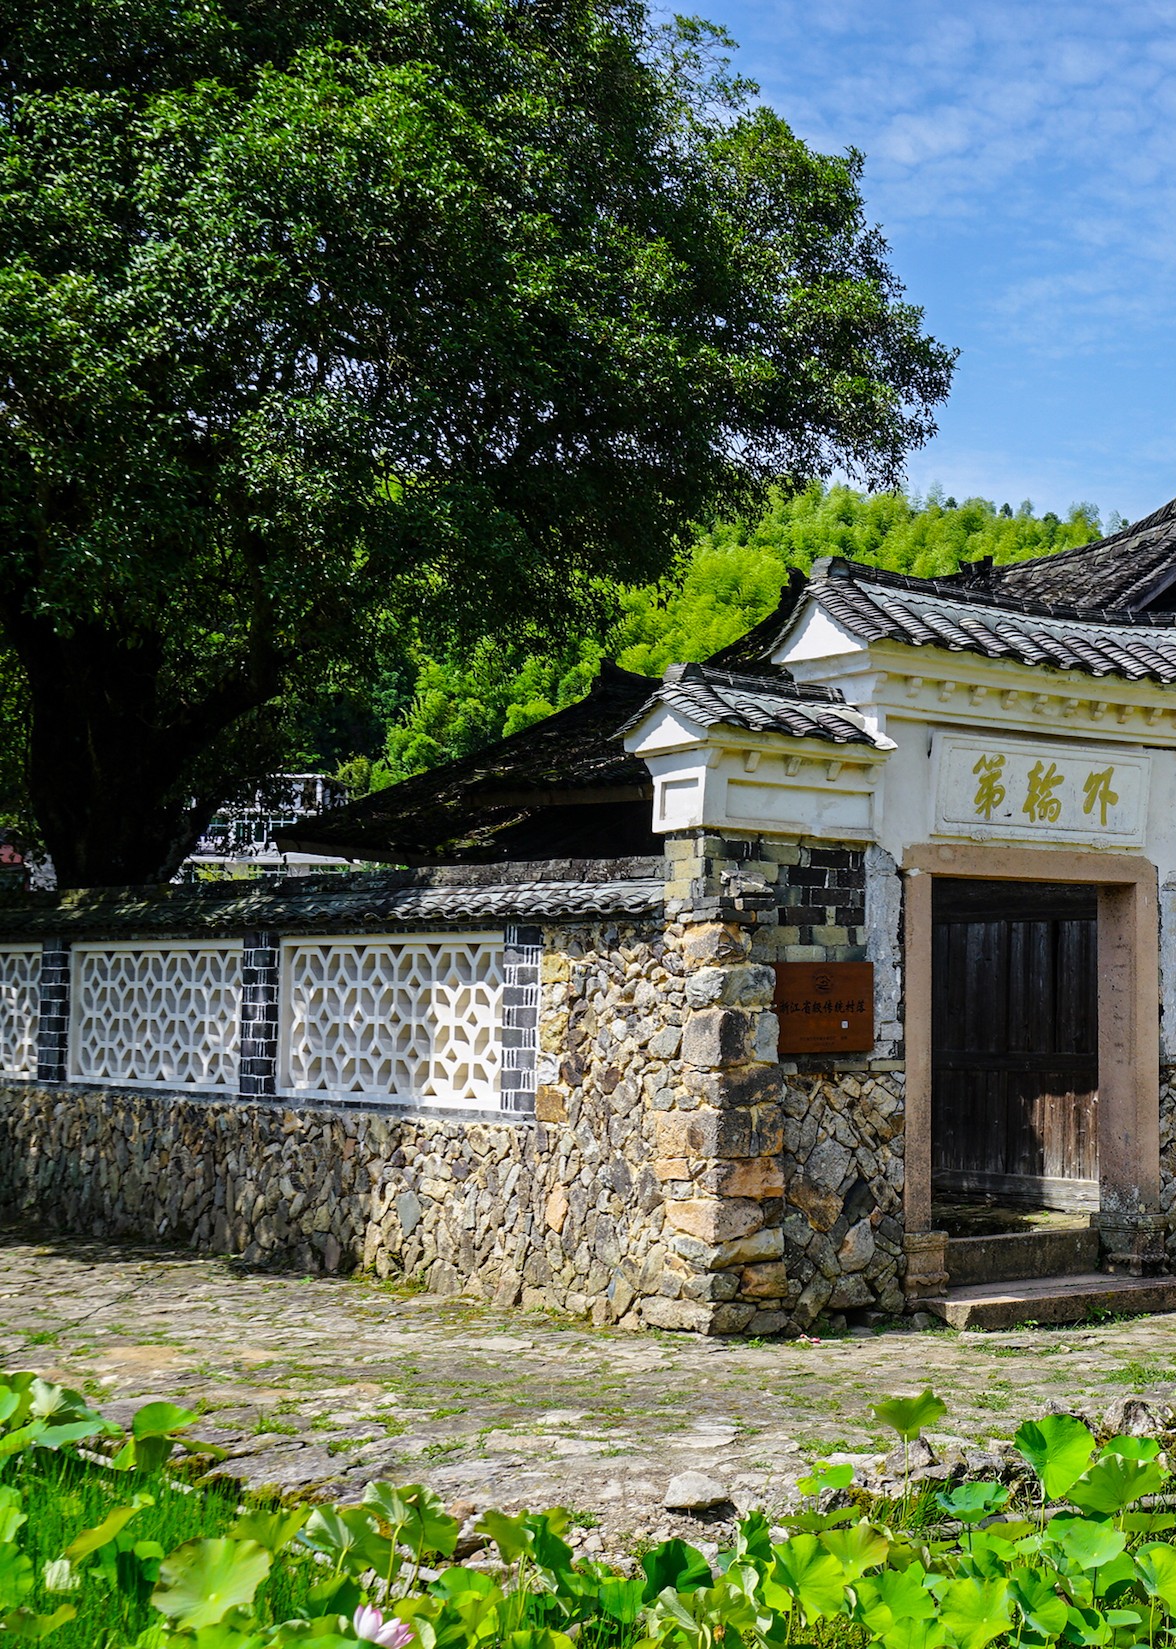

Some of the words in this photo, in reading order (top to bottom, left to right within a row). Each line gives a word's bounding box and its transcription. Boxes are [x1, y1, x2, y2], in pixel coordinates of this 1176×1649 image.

[779, 1000, 866, 1014] 浙江省级传统村落
